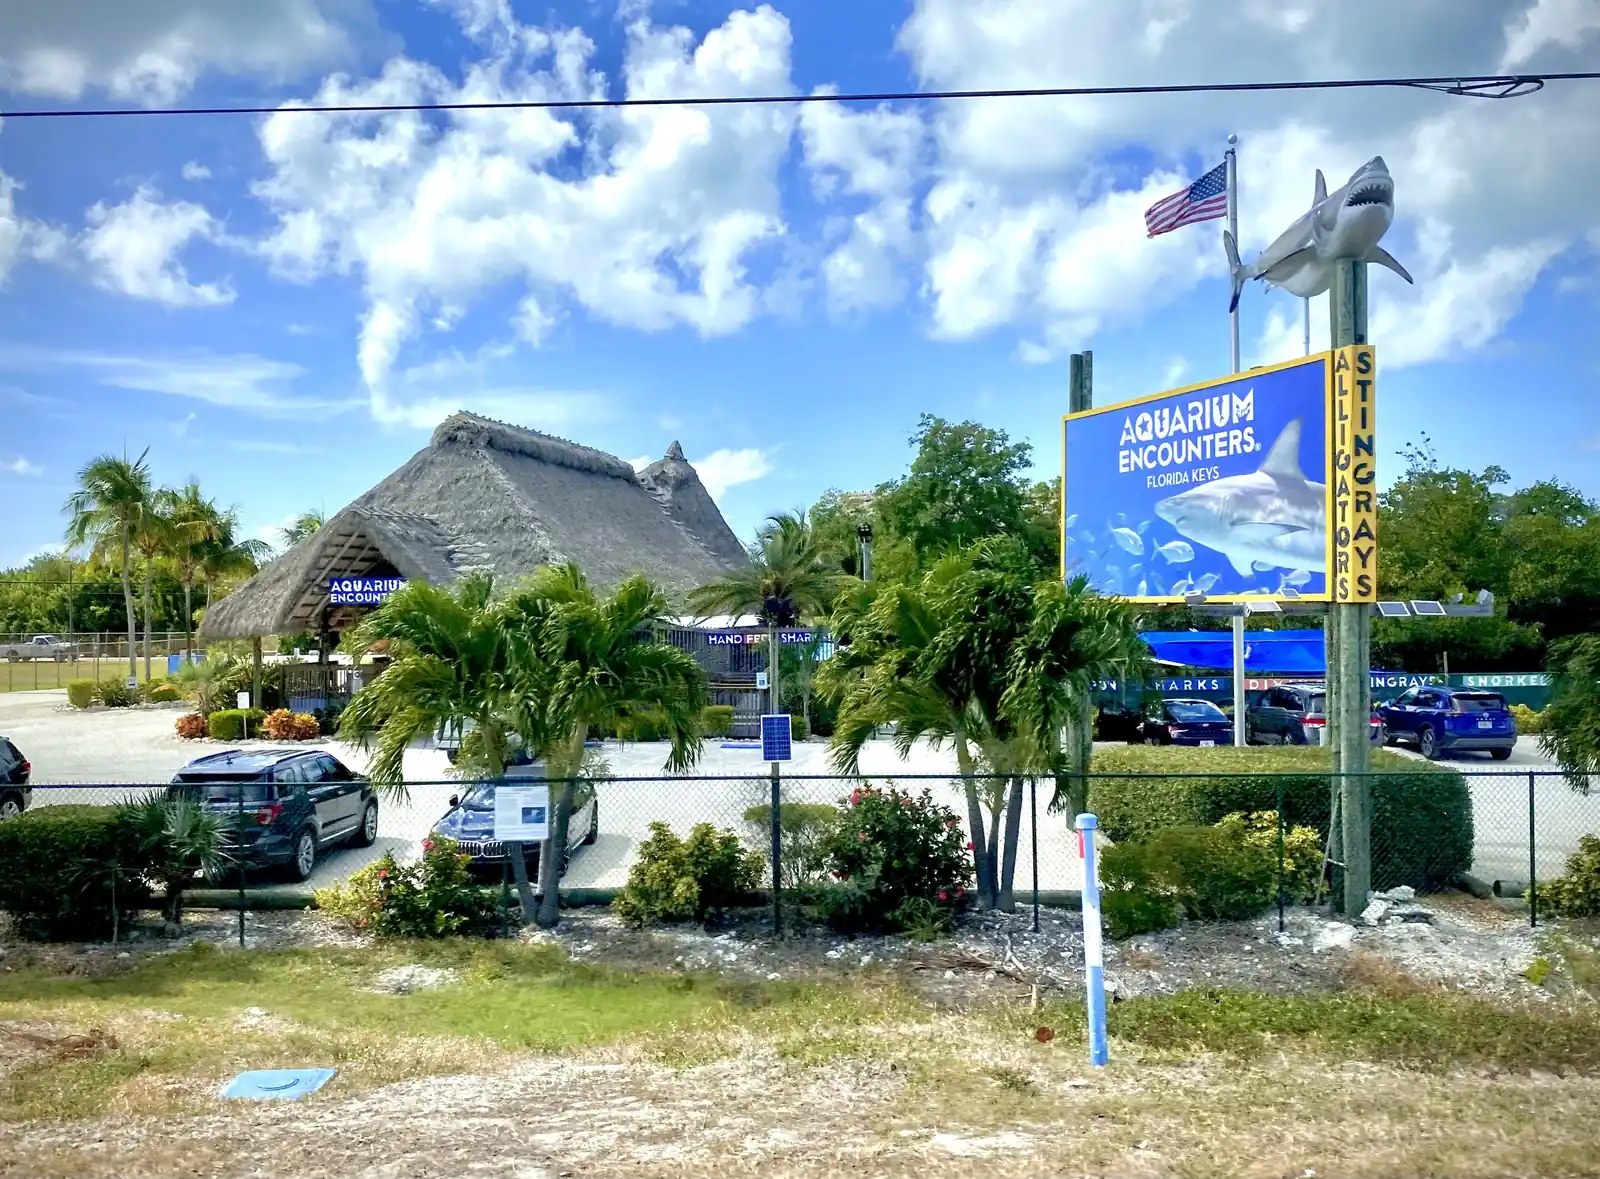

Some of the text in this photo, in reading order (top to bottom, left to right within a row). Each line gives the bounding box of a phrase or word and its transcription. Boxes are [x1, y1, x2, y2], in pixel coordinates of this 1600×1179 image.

[1119, 387, 1254, 446] AQUARIUM
[1146, 465, 1220, 489] FLORIDA KEYS
[1335, 349, 1351, 600] ALLIGATORS
[1353, 351, 1376, 597] STINGRAYS
[330, 592, 394, 603] ENCOUNT
[708, 634, 743, 645] HAND
[781, 632, 814, 643] SHAR
